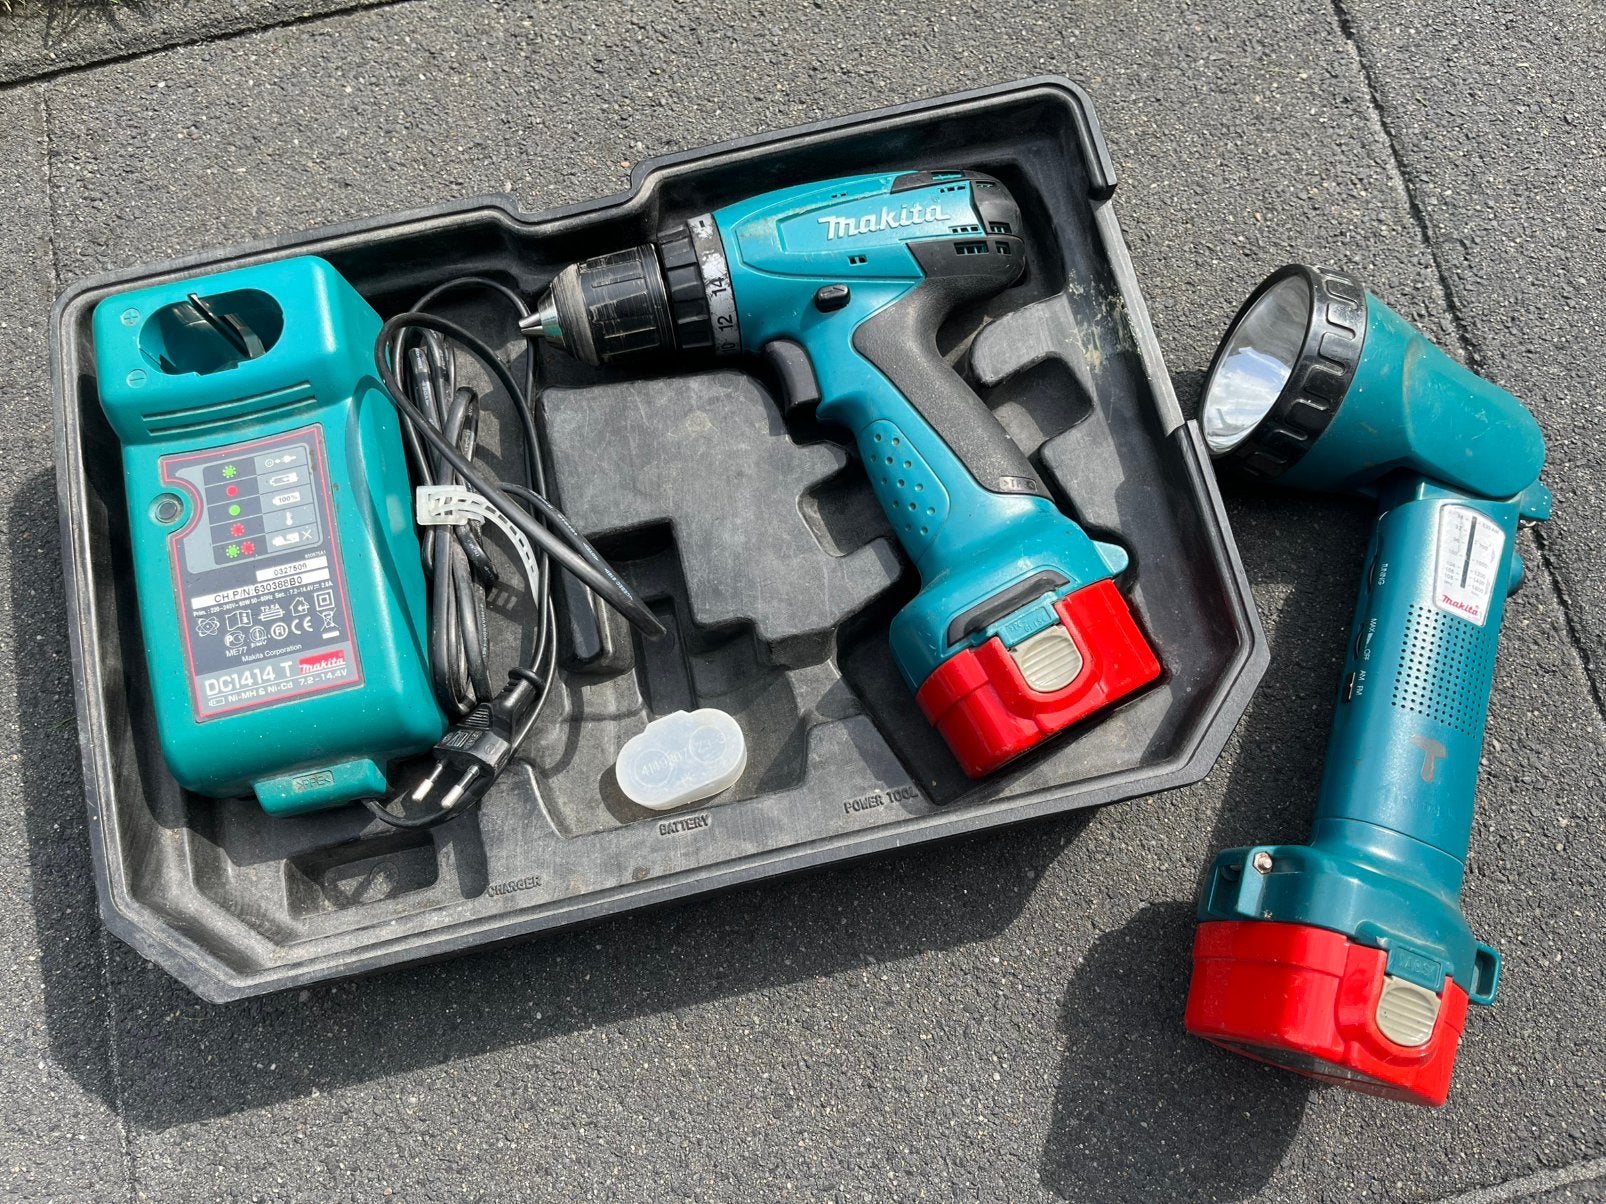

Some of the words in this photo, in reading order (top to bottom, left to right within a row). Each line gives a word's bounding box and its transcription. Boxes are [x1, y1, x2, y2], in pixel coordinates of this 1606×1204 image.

[711, 275, 726, 298] 14
[718, 314, 735, 332] 12
[242, 651, 264, 663] Makita
[264, 643, 302, 658] Corporation
[204, 665, 276, 696] DC1414
[279, 661, 293, 677] T
[1358, 669, 1367, 681] AM
[228, 690, 257, 702] Ni-MH
[258, 687, 266, 695] &
[267, 682, 293, 693] Ni-Cd
[1356, 685, 1364, 696] FM
[843, 794, 883, 814] POWER
[887, 785, 919, 804] TOOL
[659, 813, 709, 836] BATTERY
[487, 875, 542, 898] CHARGER
